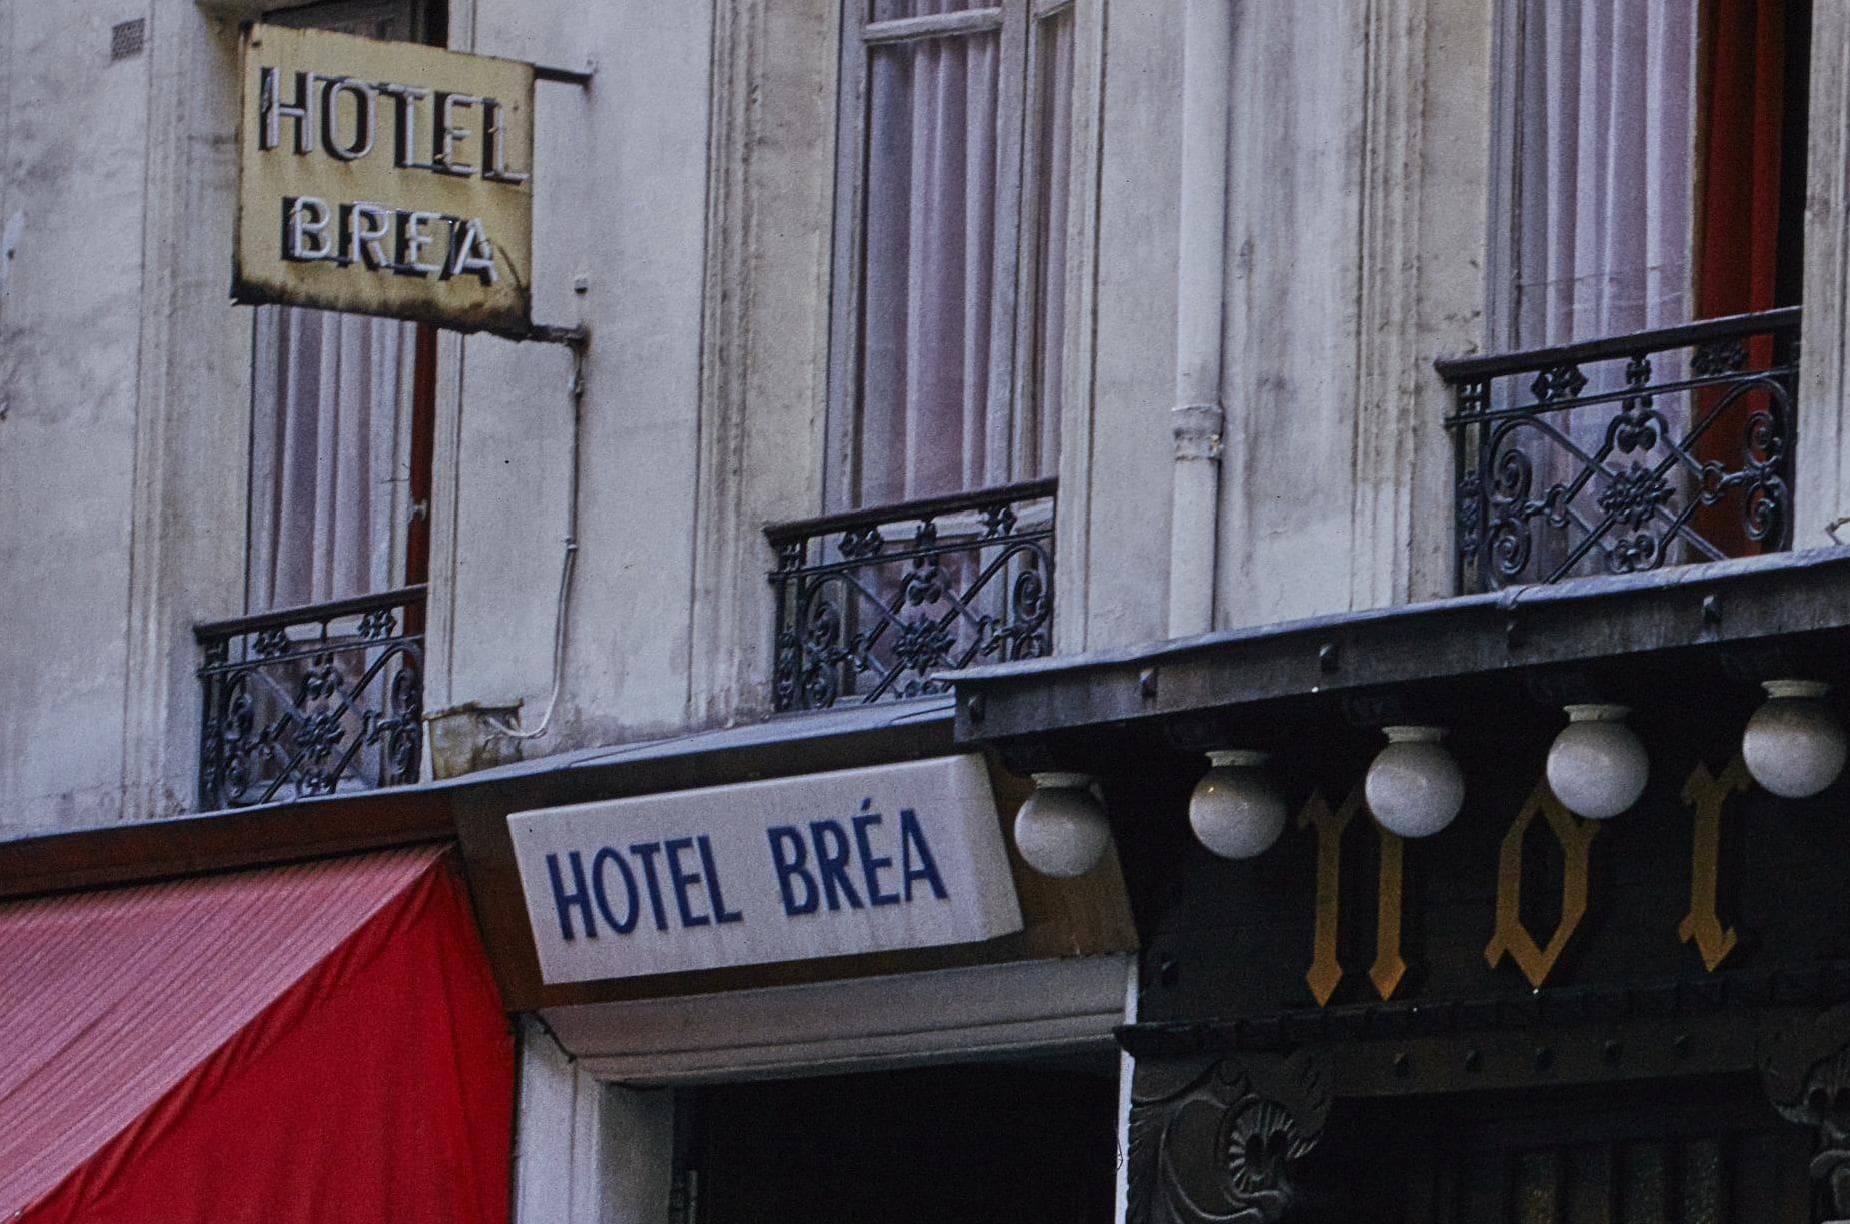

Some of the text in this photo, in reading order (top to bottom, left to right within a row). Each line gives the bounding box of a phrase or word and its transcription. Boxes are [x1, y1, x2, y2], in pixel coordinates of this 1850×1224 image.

[259, 66, 530, 184] HOTEL
[281, 196, 498, 287] BREA
[546, 797, 949, 943] HOTEL BRÉA
